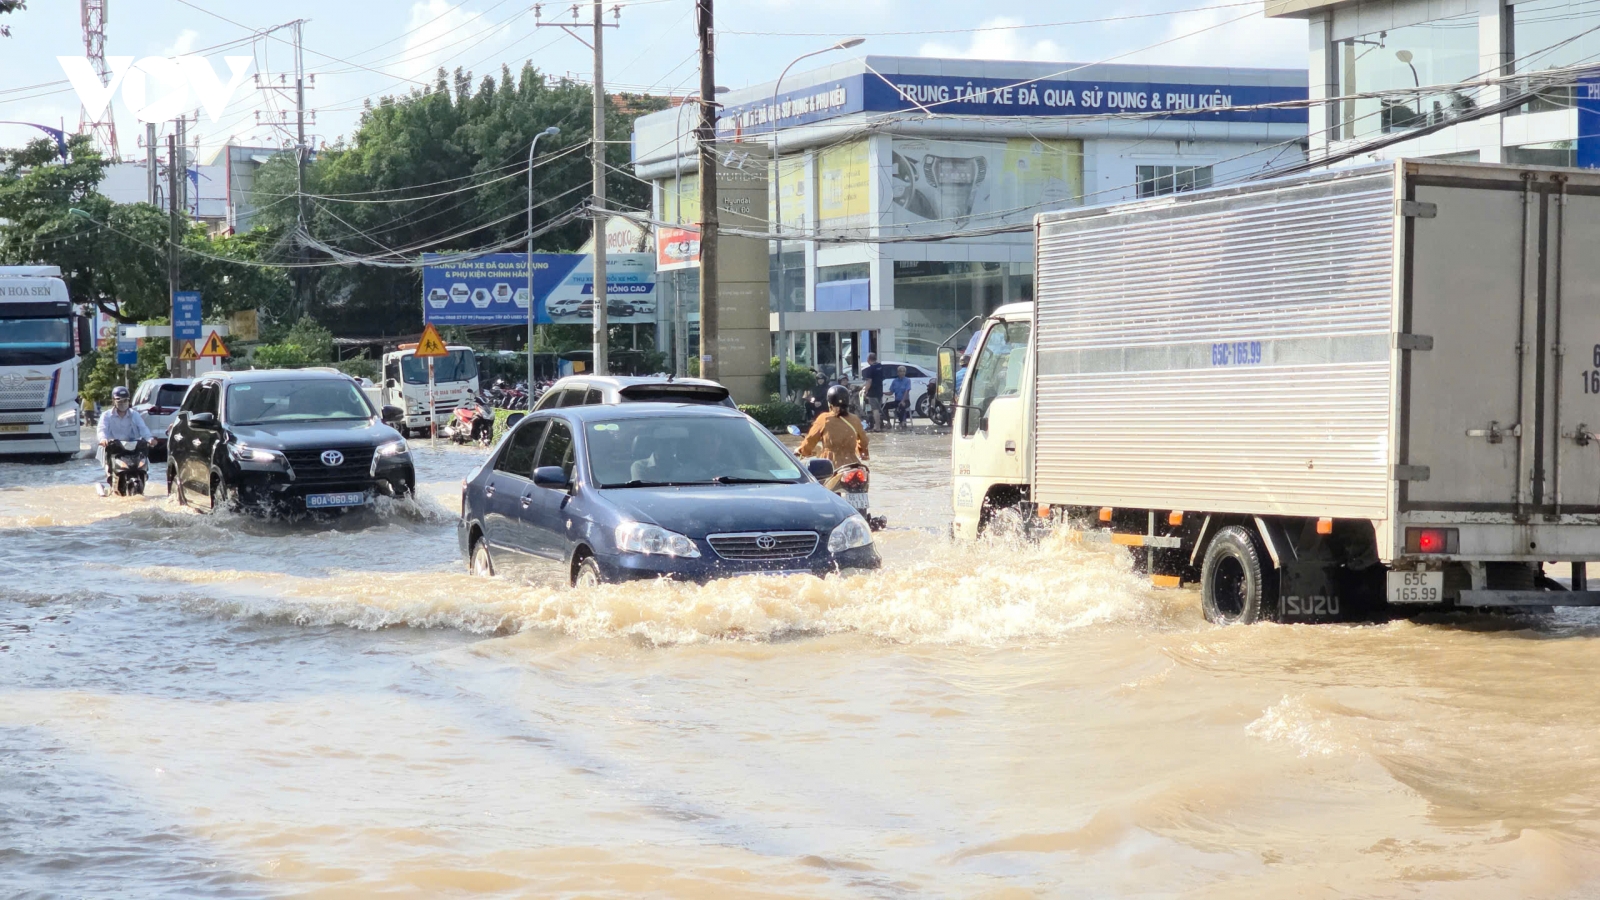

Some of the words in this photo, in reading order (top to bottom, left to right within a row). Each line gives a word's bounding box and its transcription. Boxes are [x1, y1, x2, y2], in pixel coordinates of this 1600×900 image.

[897, 83, 949, 102] TRUNG
[954, 81, 987, 104] TÂM
[992, 87, 1013, 105] XE
[1018, 84, 1039, 106] ĐÃ
[1044, 89, 1076, 107] QUA
[1081, 86, 1103, 108] SỬ
[1107, 91, 1147, 113] DỤNG
[1151, 92, 1162, 110] &
[1199, 89, 1232, 115] KIỆN
[452, 271, 468, 279] PHỤ
[469, 270, 486, 279] KIỆN
[8, 287, 29, 296] HOA
[607, 283, 629, 293] HỒNG
[1212, 341, 1262, 366] 65C-165.99
[1404, 573, 1427, 586] 65C
[1395, 587, 1437, 601] 165.99
[1281, 595, 1340, 615] ISUZU
